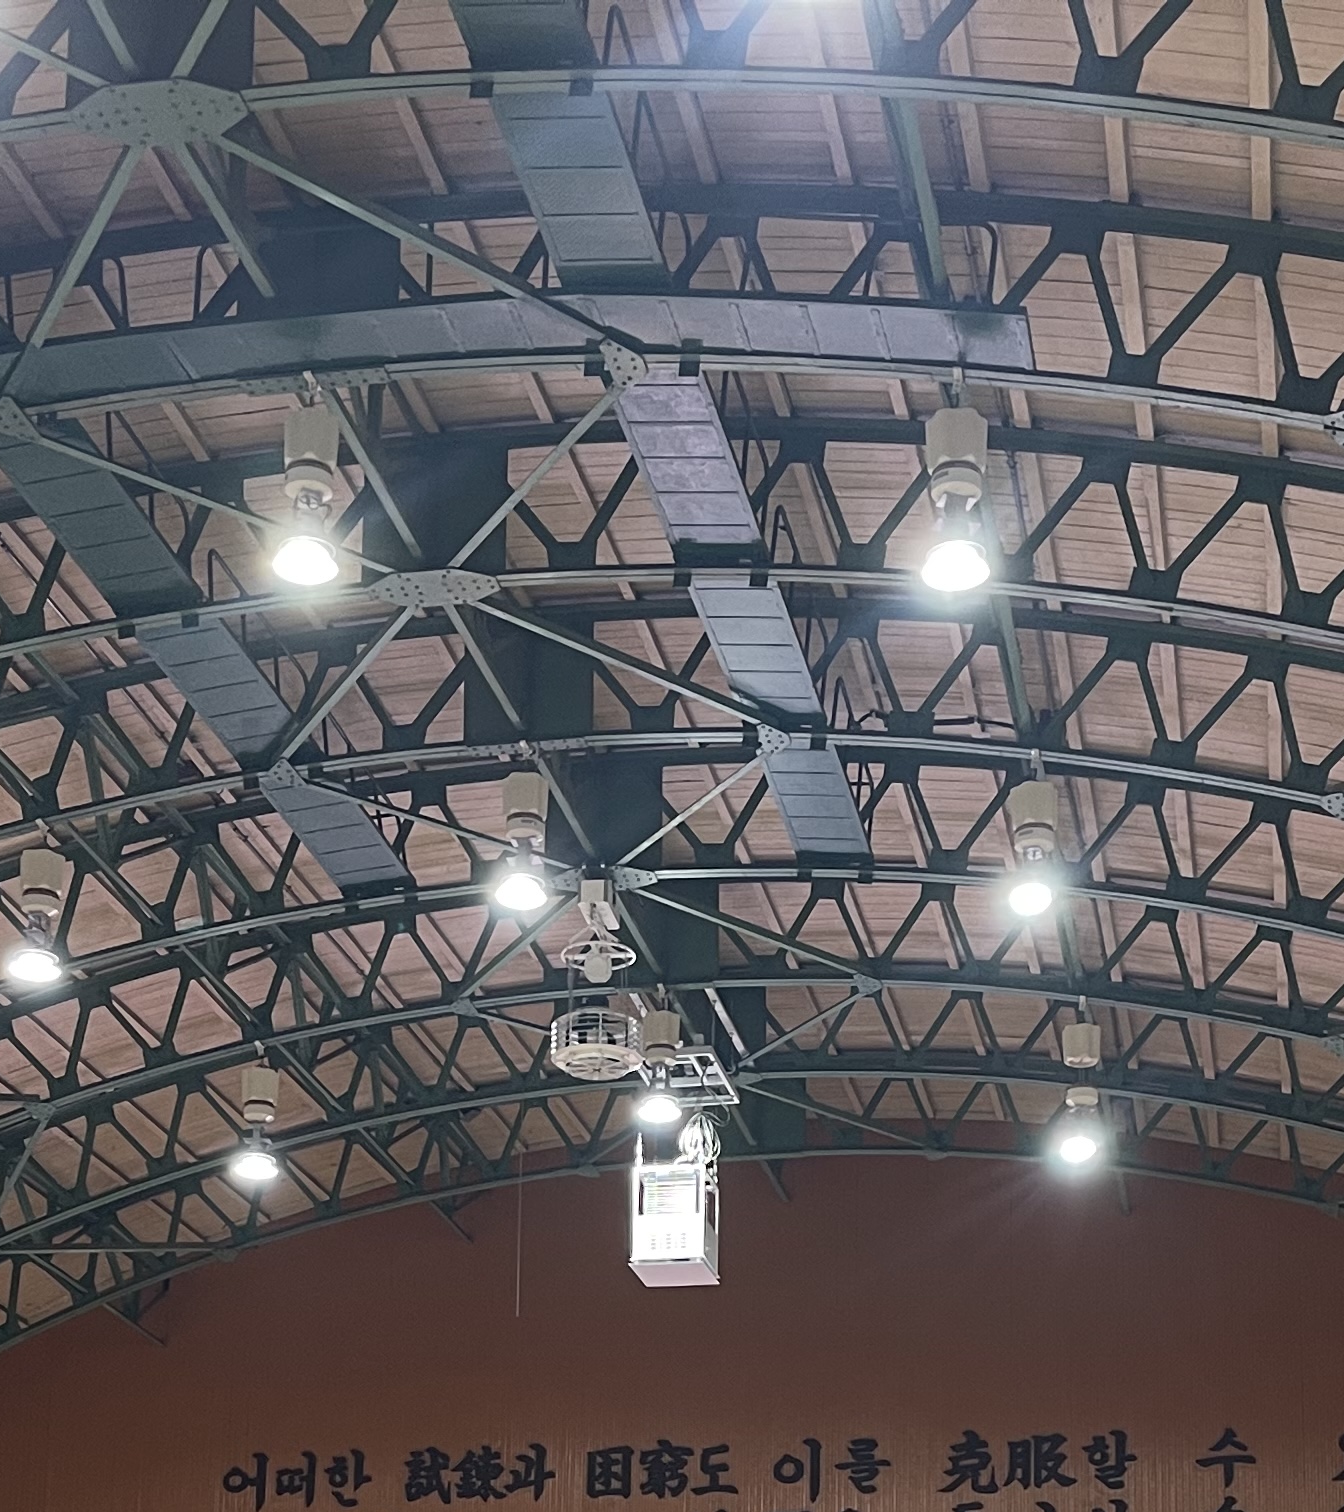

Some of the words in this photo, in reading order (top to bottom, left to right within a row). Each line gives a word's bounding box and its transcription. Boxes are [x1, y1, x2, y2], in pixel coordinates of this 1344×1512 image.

[222, 1448, 372, 1512] 어떠한
[586, 1439, 738, 1499] 困窮도
[773, 1437, 891, 1503] 이를
[937, 1430, 1138, 1495] 克服할
[1195, 1427, 1257, 1488] 수
